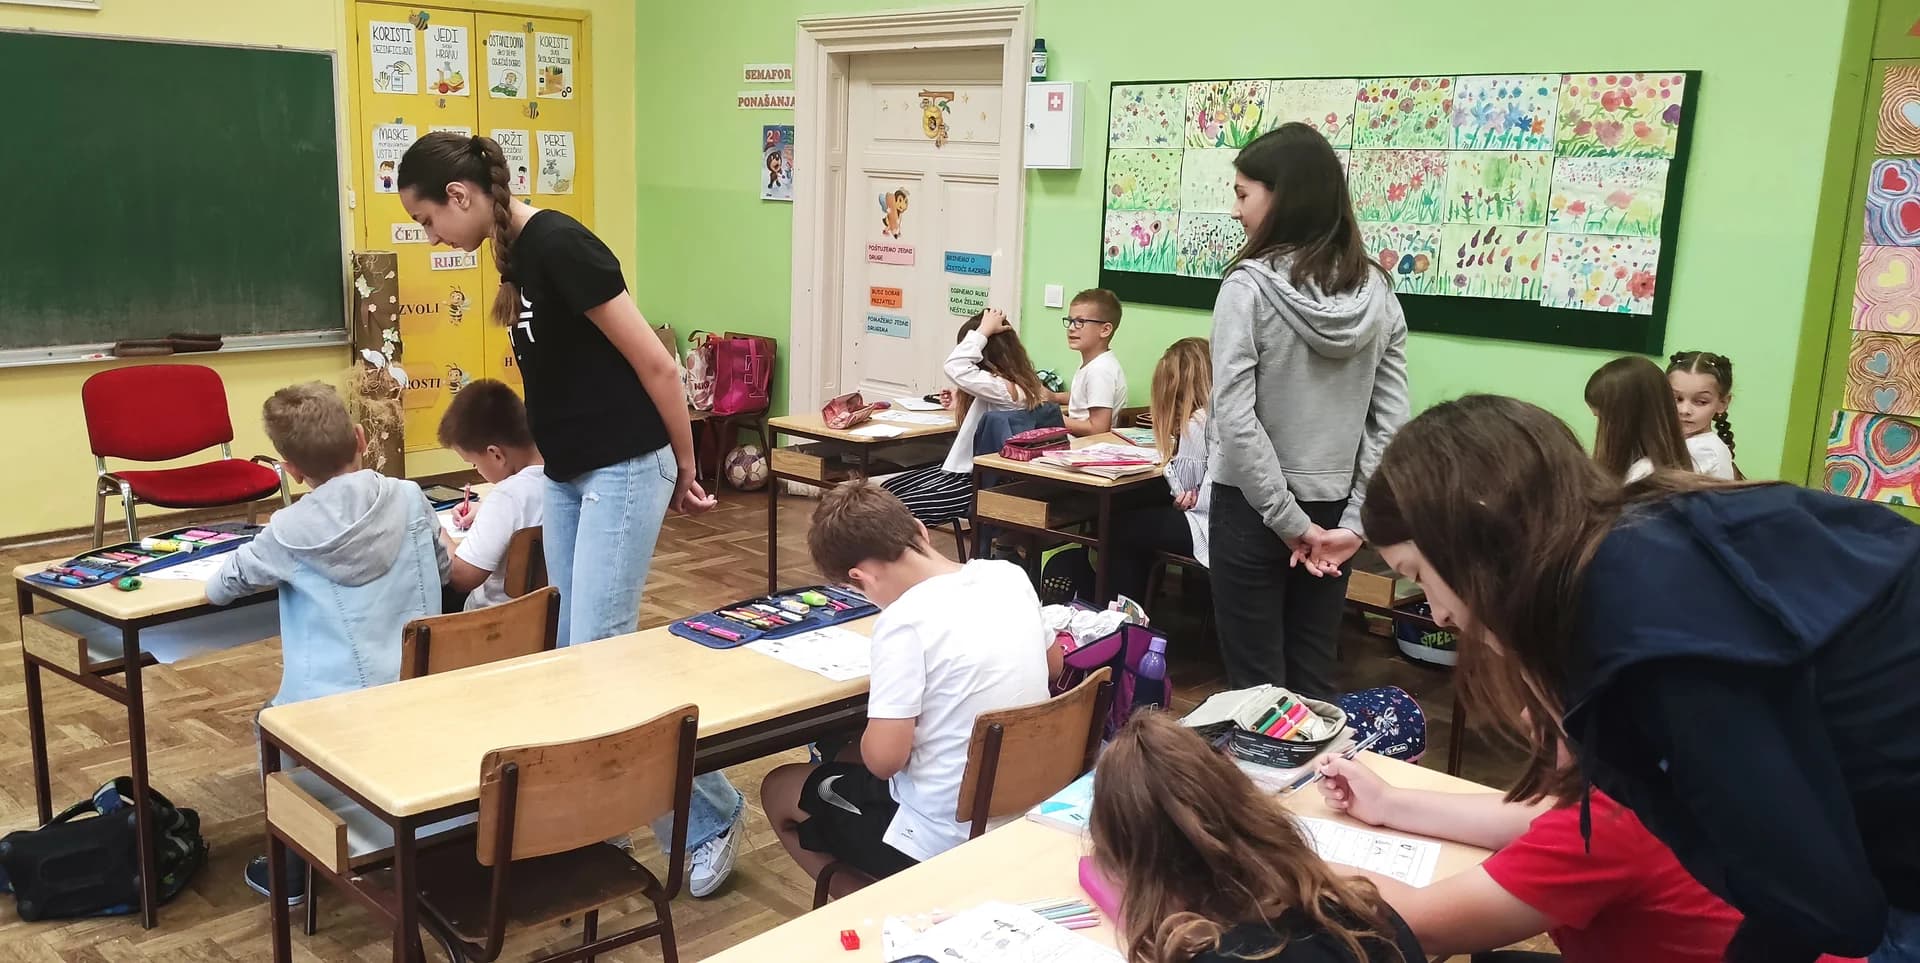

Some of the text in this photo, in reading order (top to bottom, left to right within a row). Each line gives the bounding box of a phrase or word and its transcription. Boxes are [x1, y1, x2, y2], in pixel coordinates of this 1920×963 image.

[373, 26, 412, 42] KORISTI
[434, 28, 459, 43] JEDI
[540, 36, 569, 50] KORISTI
[436, 49, 459, 59] HRANU
[745, 69, 791, 80] SEMAFOR
[738, 94, 795, 107] PONAŠANJA
[378, 128, 408, 141] MASKE
[498, 131, 523, 146] DRŽI
[544, 134, 566, 146] PERI
[376, 149, 392, 159] USTA
[546, 148, 568, 158] RUKE
[434, 253, 476, 268] RIJEČI
[399, 303, 439, 316] ZVOLI
